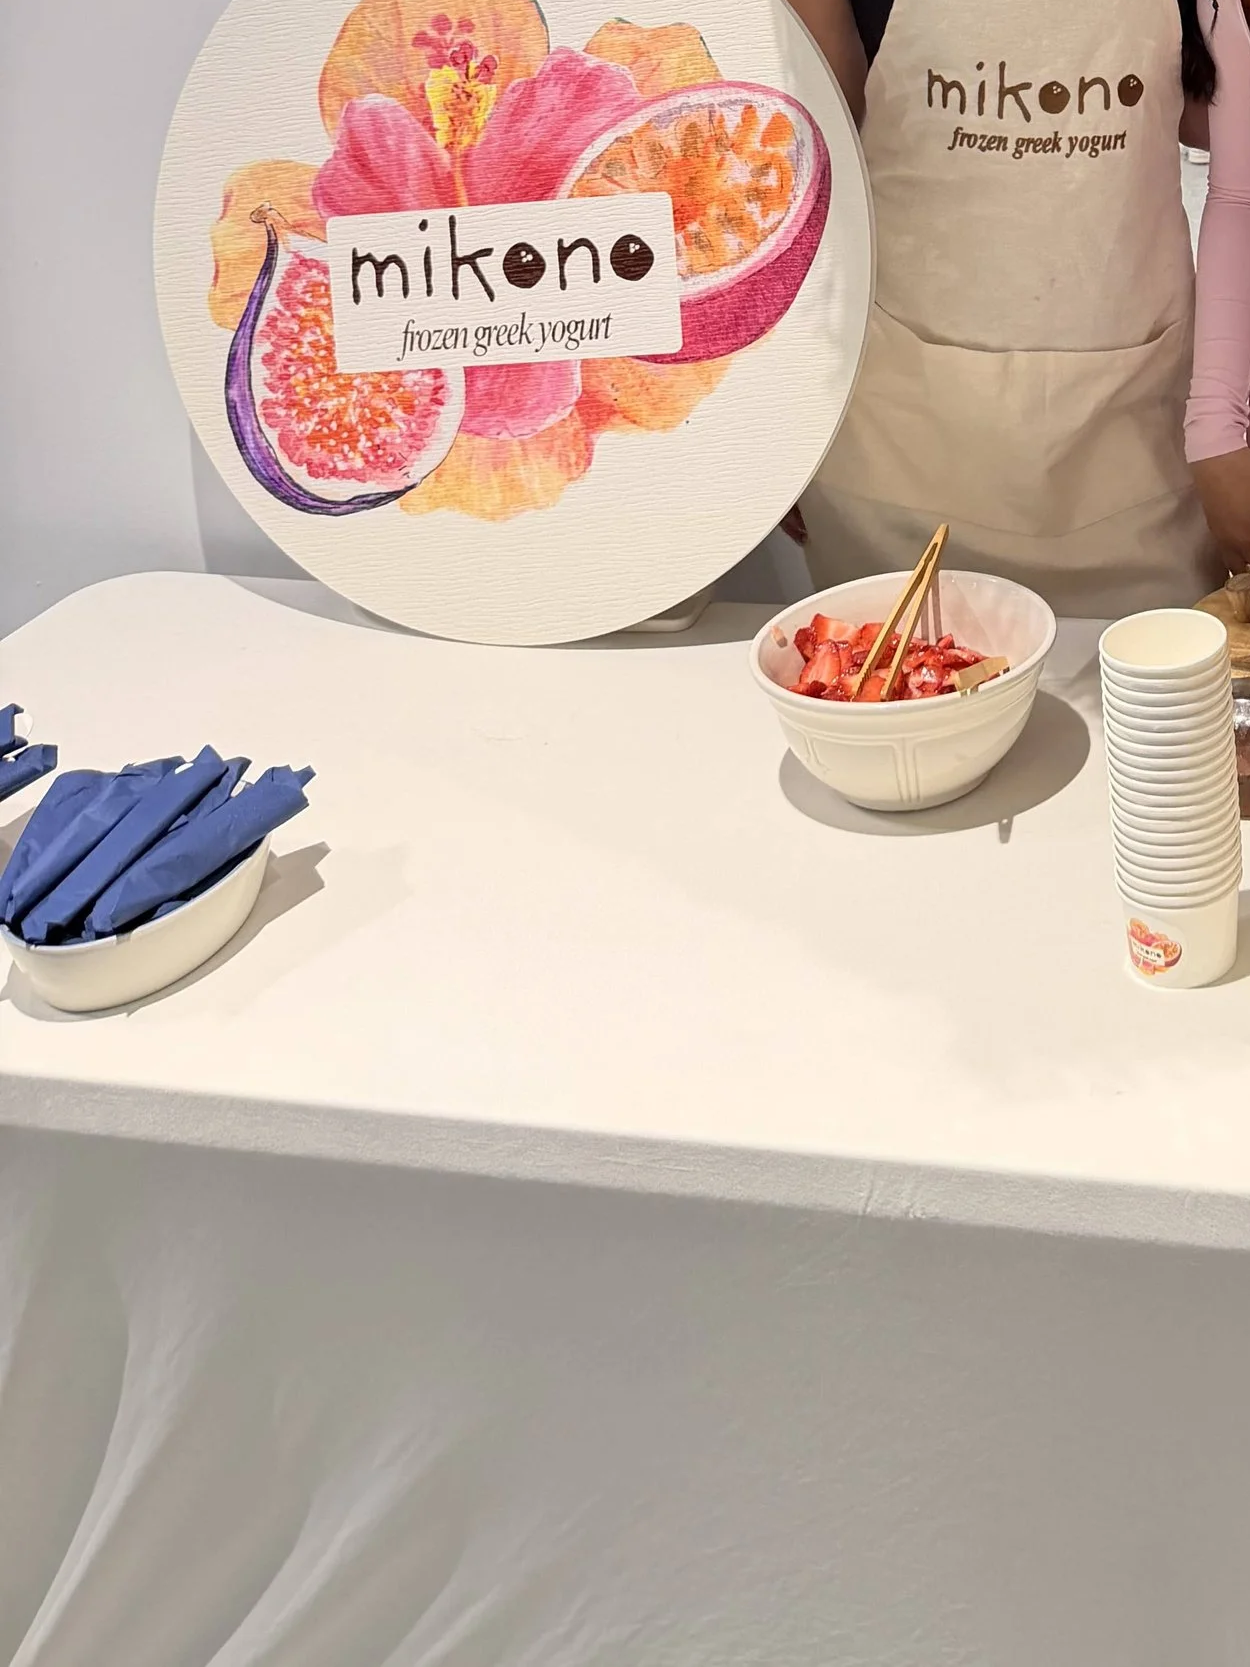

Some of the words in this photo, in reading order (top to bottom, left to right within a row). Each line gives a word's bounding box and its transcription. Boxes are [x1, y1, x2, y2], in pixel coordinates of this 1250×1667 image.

[927, 61, 1144, 123] mikono
[948, 127, 1008, 152] frozen
[1012, 131, 1062, 159] greek
[1065, 130, 1127, 158] yogurt
[352, 215, 654, 304] mikono
[397, 319, 468, 361] frozen
[474, 312, 534, 357] greek
[535, 313, 613, 353] yogurt
